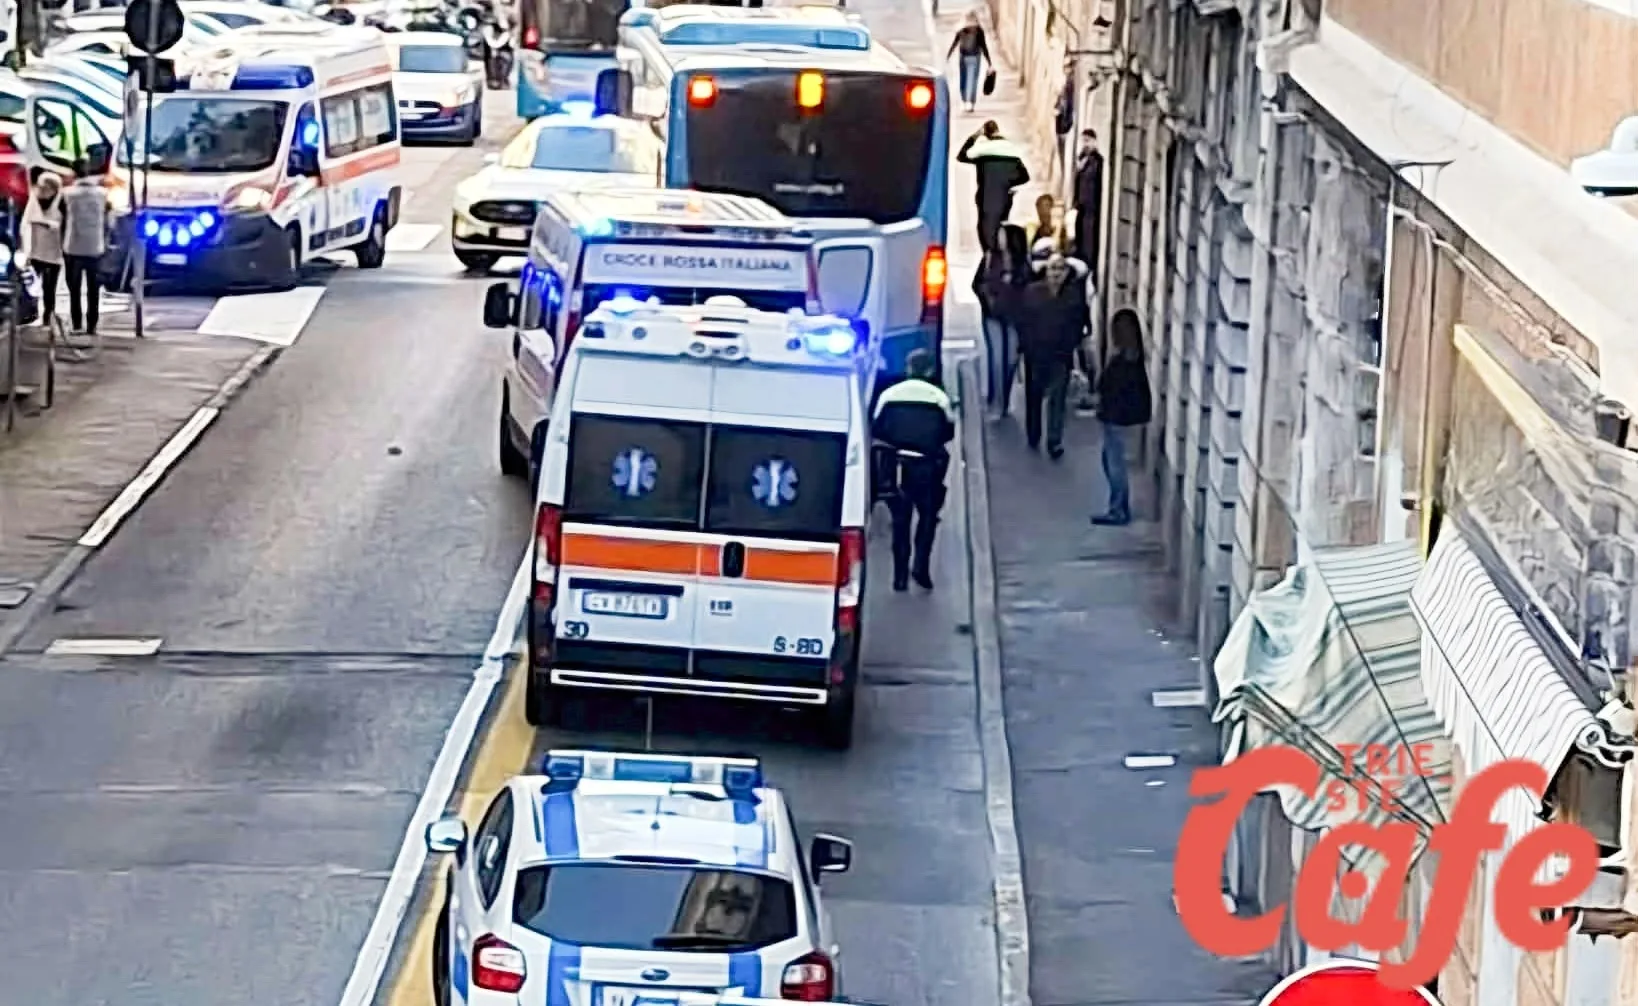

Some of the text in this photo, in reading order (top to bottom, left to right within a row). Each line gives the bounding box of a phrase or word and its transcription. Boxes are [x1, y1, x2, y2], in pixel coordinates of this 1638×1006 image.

[603, 253, 792, 271] CROCE ROSSA ITALIANA
[564, 620, 590, 639] 30
